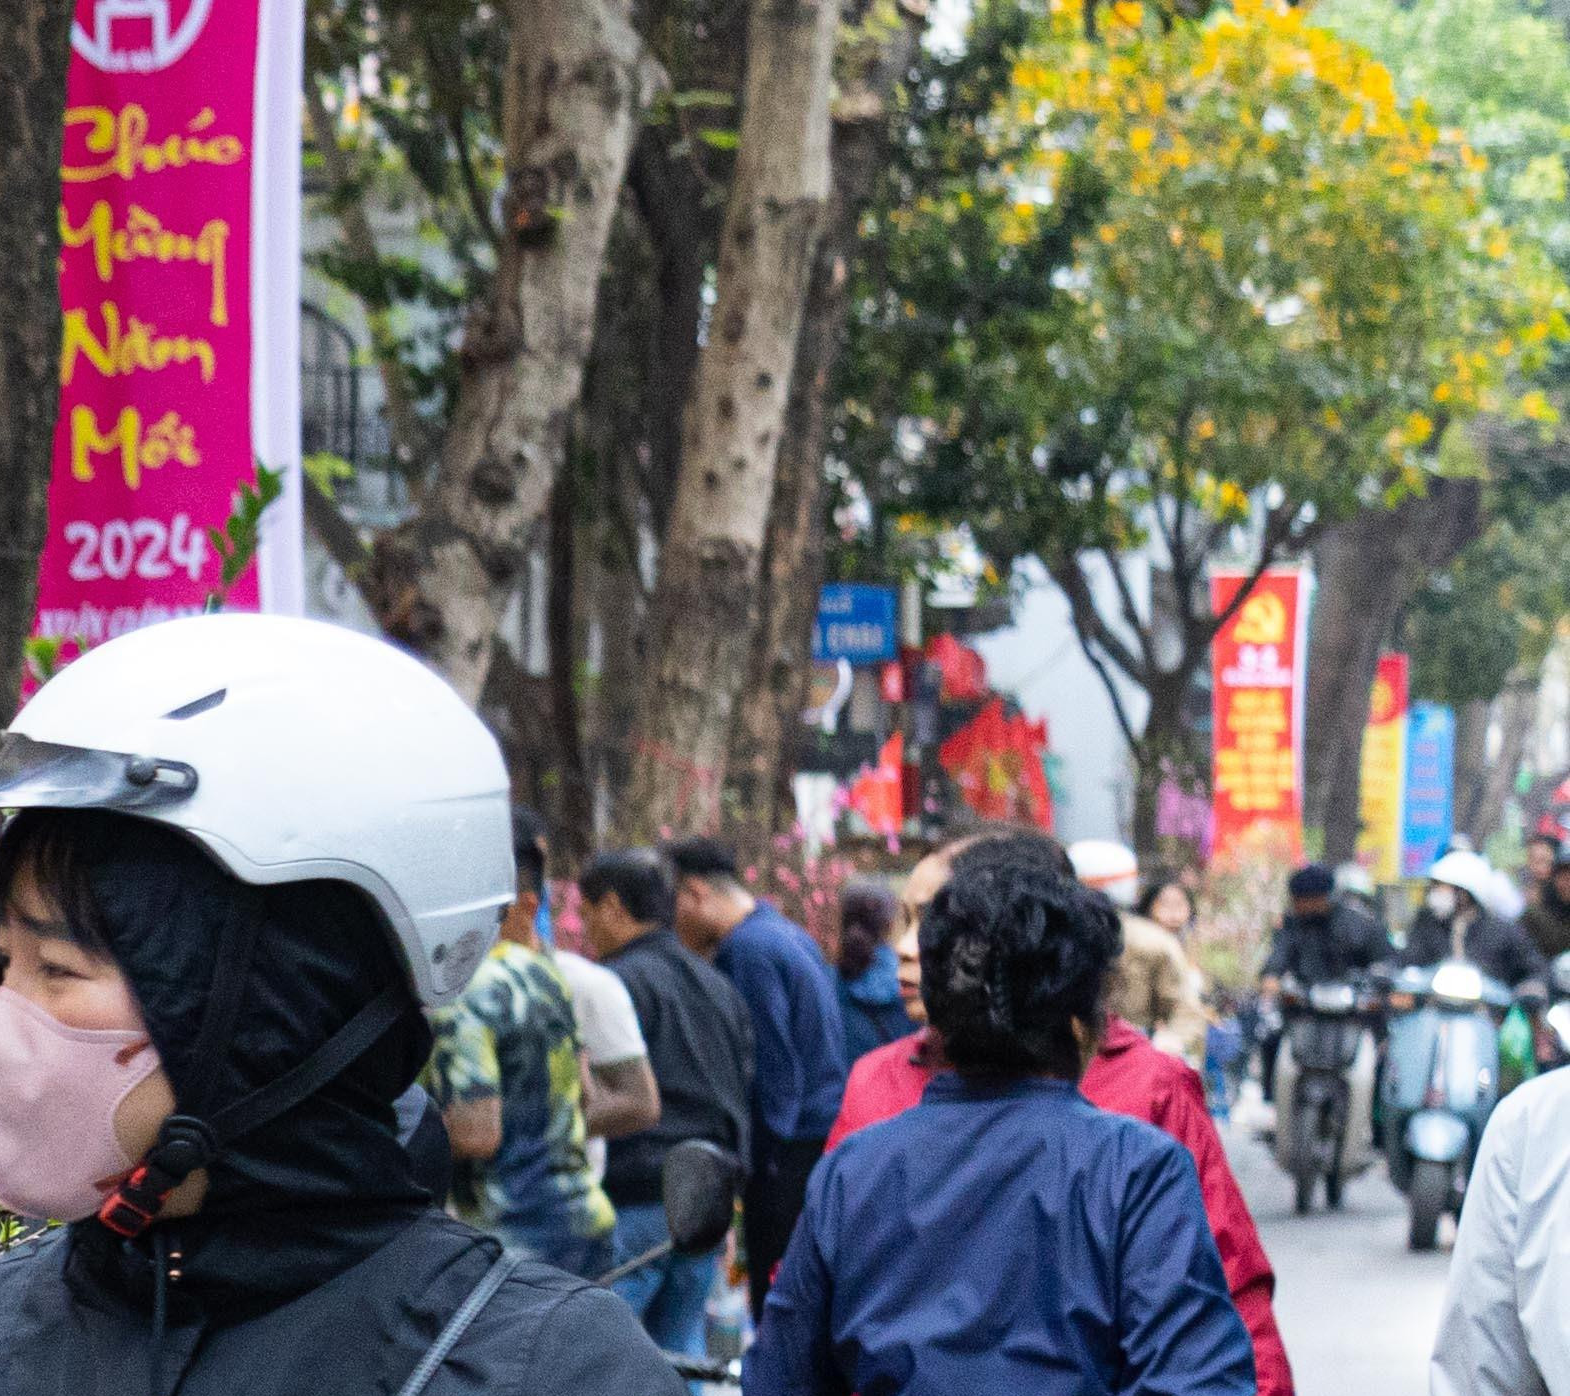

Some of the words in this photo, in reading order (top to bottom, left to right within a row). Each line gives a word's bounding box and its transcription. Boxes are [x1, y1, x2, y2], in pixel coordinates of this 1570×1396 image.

[59, 299, 215, 385] Năm
[70, 405, 202, 490] Mới
[63, 512, 208, 581] 2024
